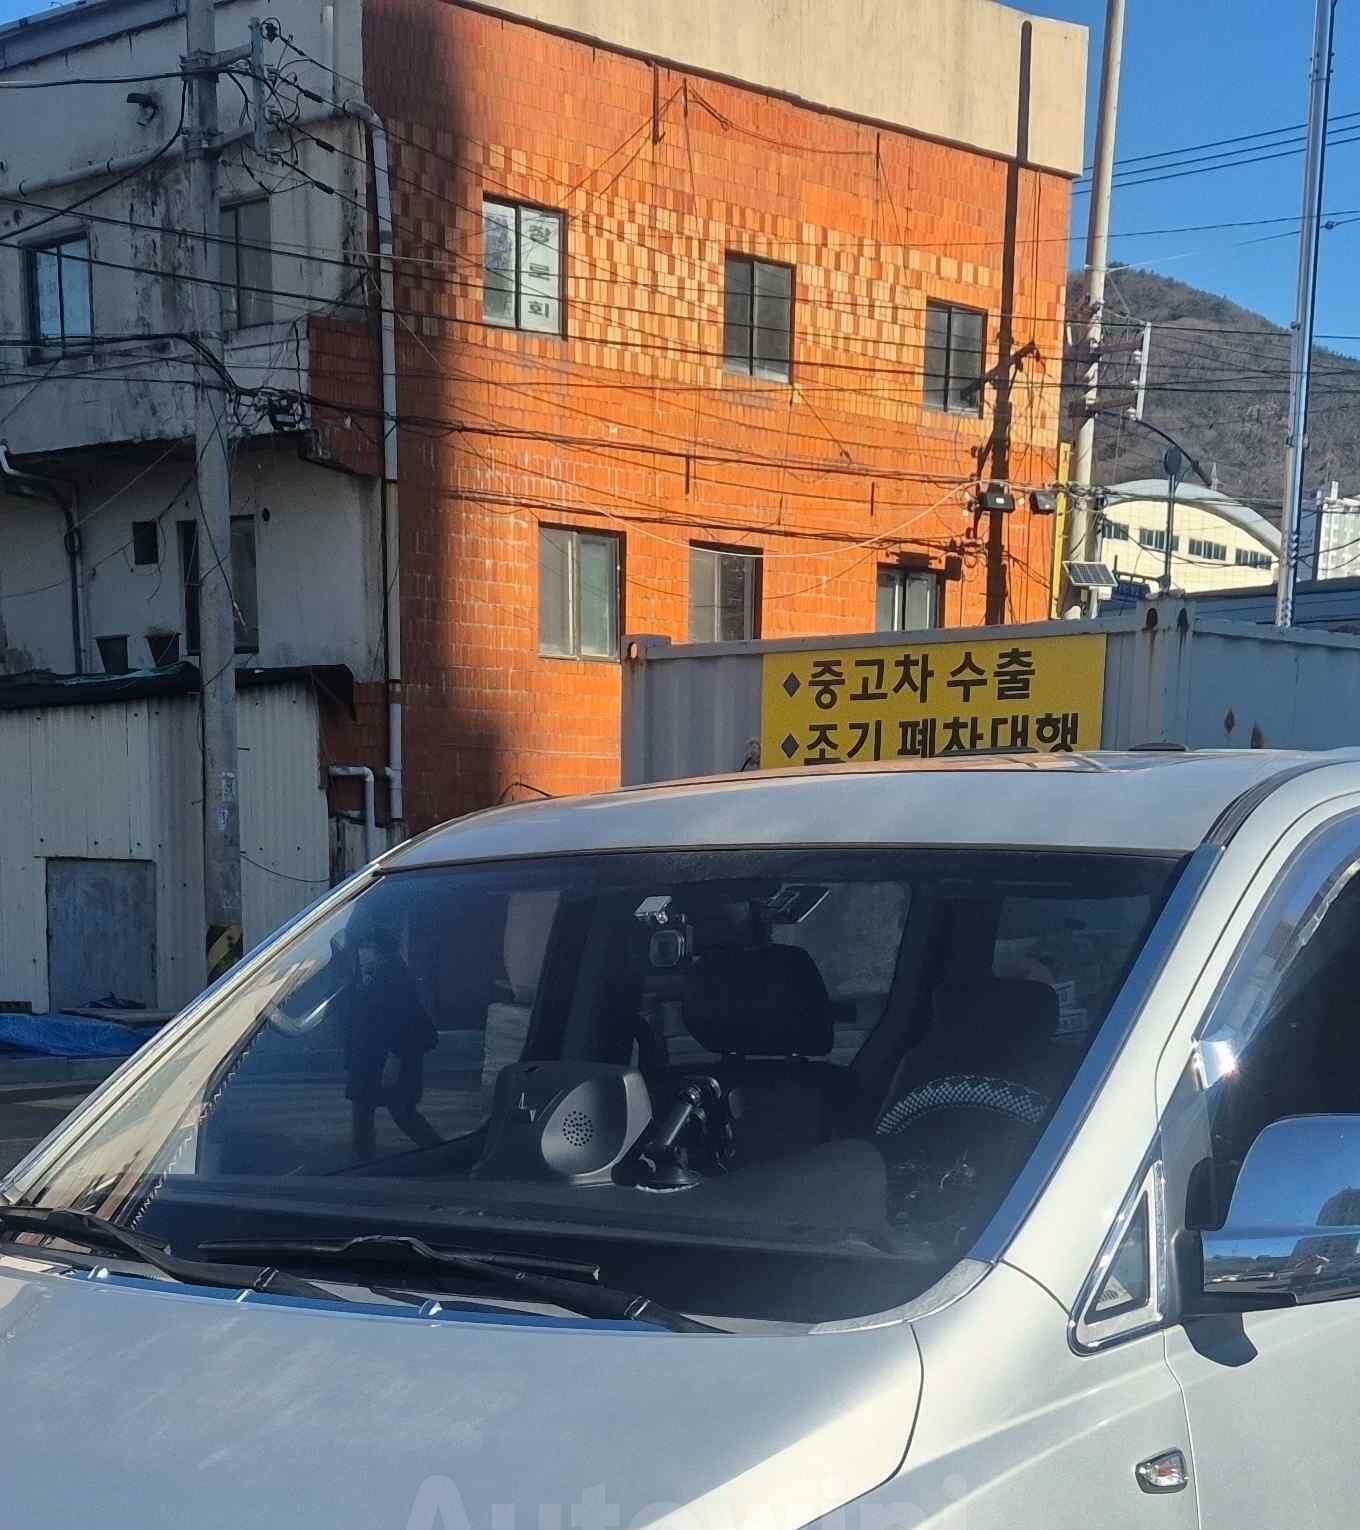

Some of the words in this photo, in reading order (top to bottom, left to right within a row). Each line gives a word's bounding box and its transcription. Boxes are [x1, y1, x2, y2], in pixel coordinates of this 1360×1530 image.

[808, 653, 935, 711] 중고차
[946, 647, 1037, 703] 수출
[803, 719, 883, 767] 조기
[897, 712, 1079, 759] 폐차대행
